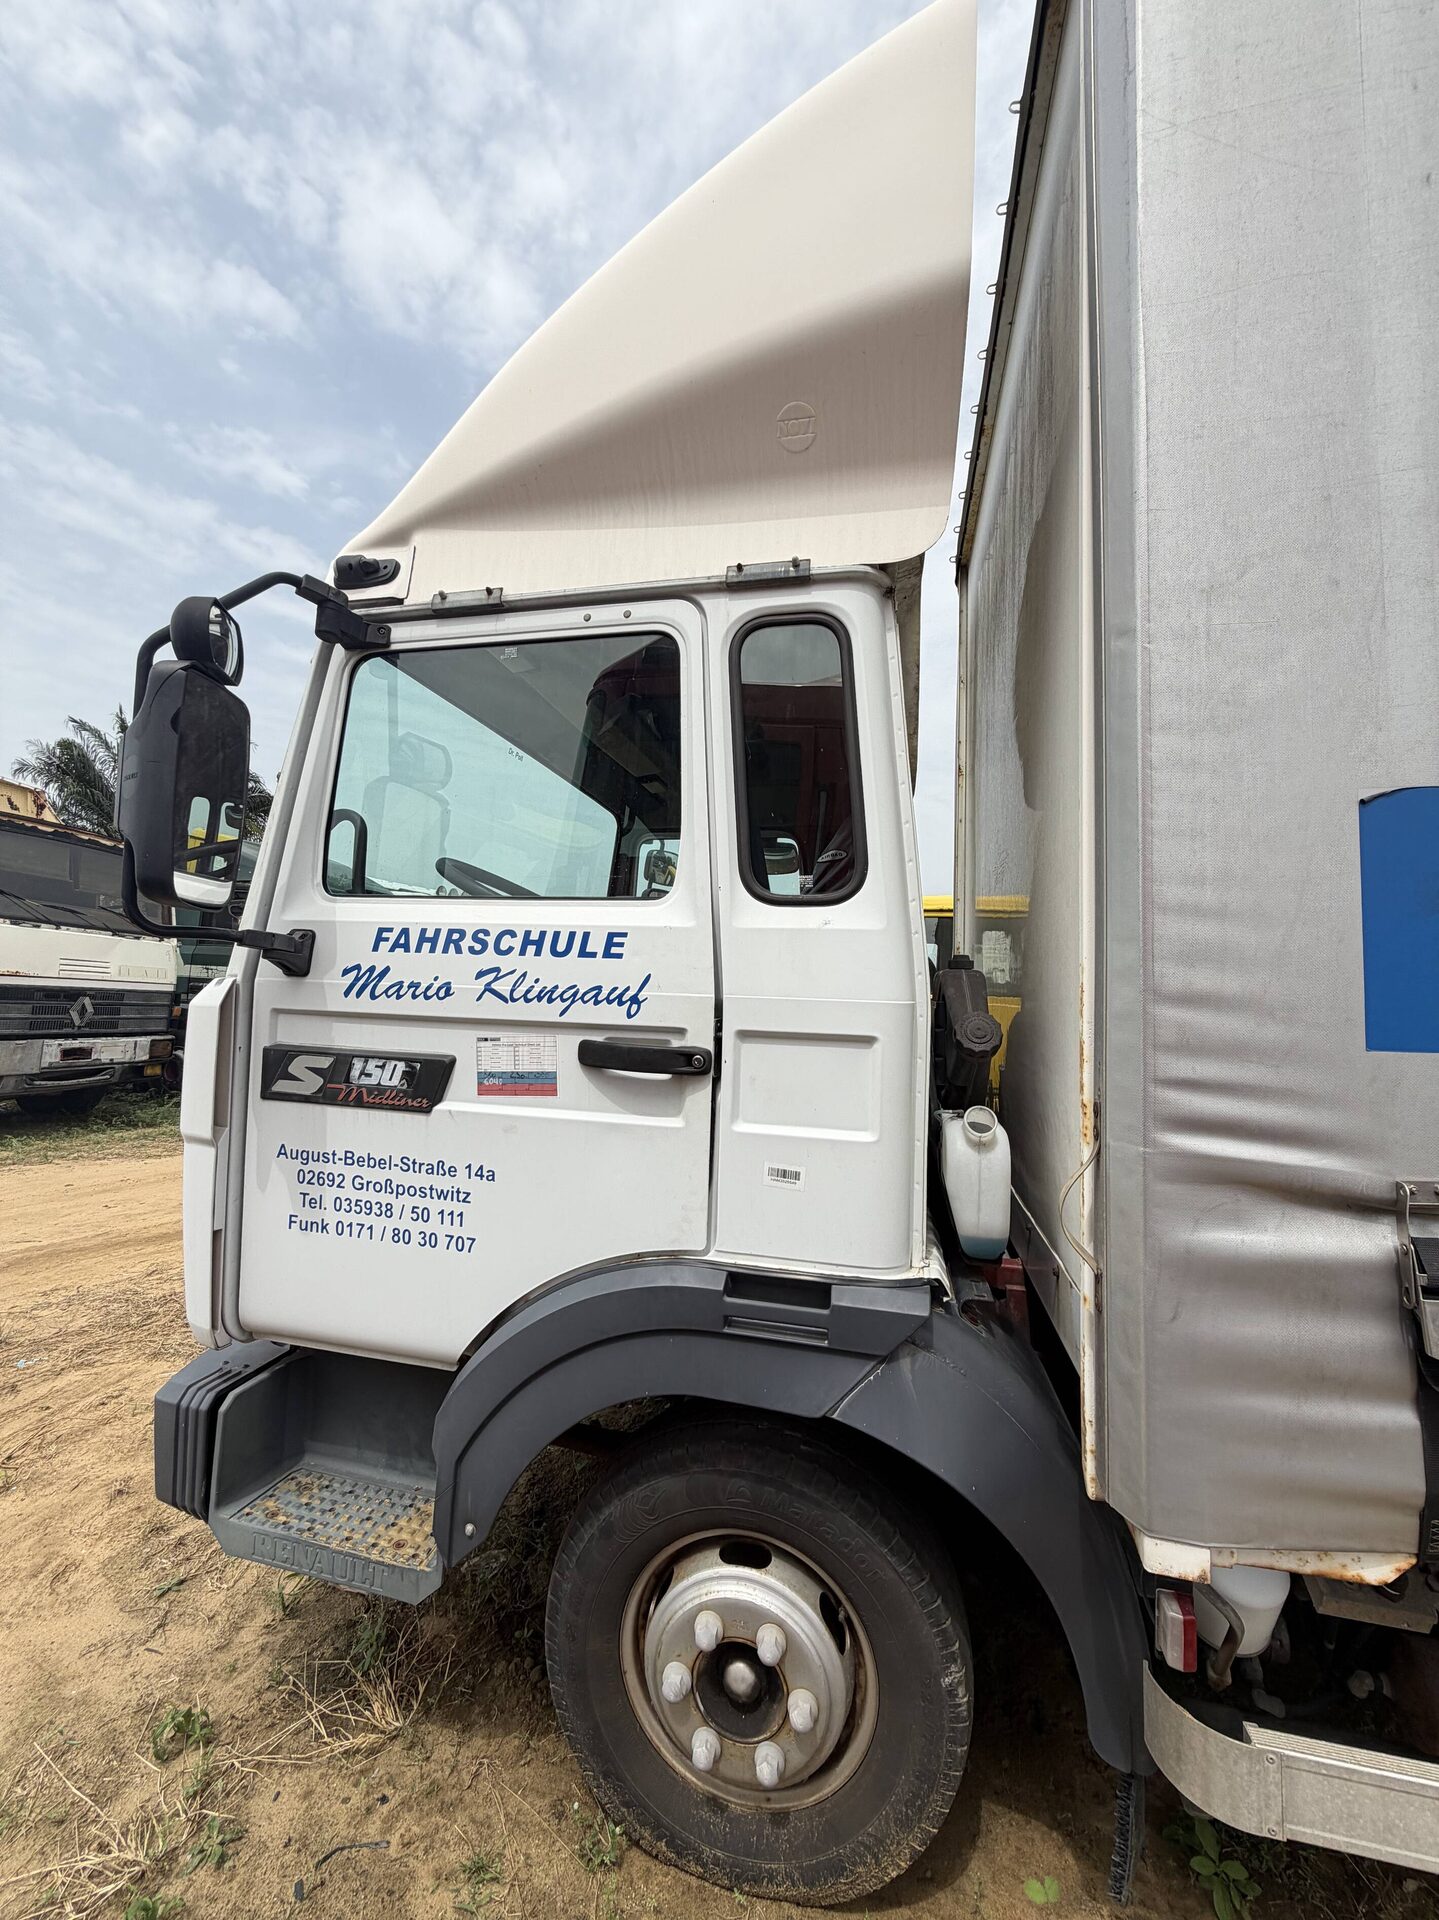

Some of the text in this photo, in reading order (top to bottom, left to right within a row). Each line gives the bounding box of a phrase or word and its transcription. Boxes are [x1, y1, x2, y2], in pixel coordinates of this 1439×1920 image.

[371, 926, 629, 960] FAHRSCHULE
[341, 963, 652, 1019] Mario Klingauf
[271, 1055, 335, 1095] S
[326, 1083, 432, 1108] Midliner
[276, 1143, 496, 1183] August-Bebel-Straße 14a
[297, 1168, 472, 1204] 02692 Großpostwitz
[299, 1191, 464, 1228] Tel. 035938 / 50 111
[288, 1214, 477, 1254] Funk 0171 / 80 30 707
[251, 1531, 389, 1592] RENAULT
